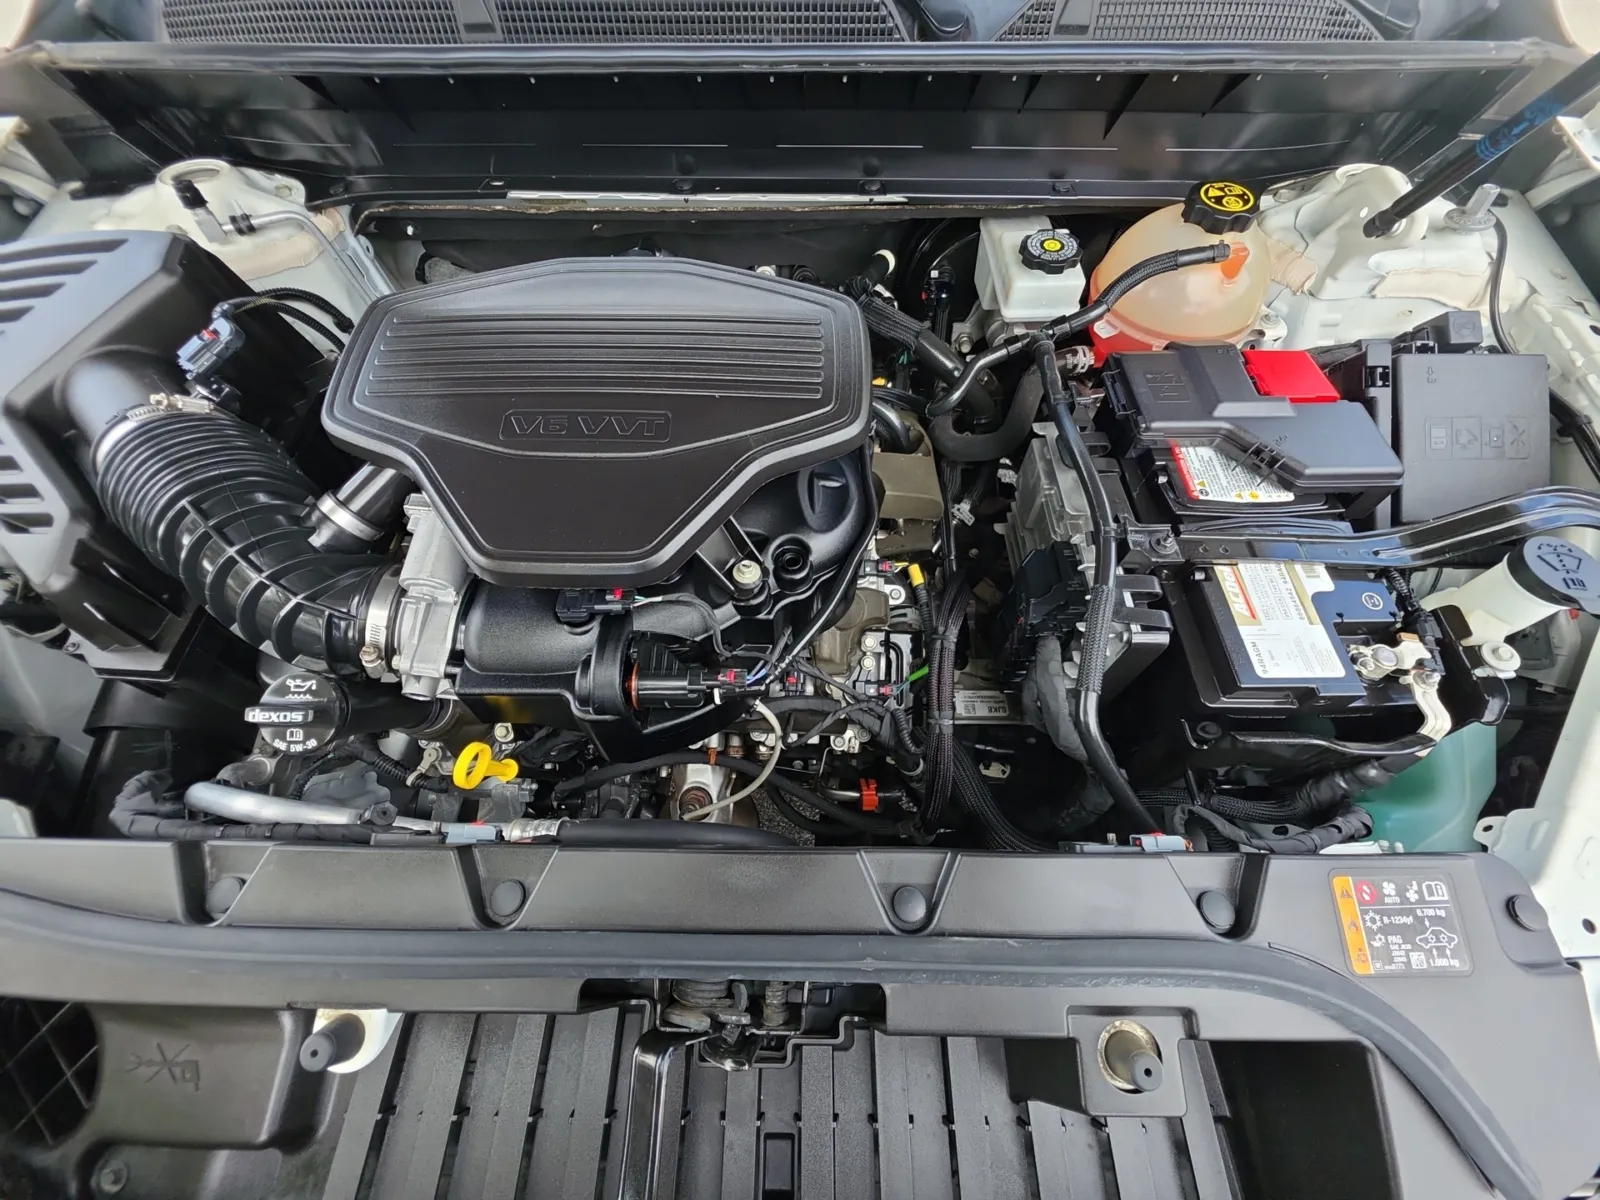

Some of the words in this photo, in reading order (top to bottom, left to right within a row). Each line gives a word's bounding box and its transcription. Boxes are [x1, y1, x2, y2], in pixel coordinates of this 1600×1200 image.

[510, 415, 568, 434] V6
[577, 416, 665, 436] VVT
[1250, 641, 1269, 675] 94RAGM
[248, 708, 305, 723] dexos
[273, 738, 288, 751] SAE
[289, 738, 318, 752] 5W-30
[1436, 908, 1446, 918] kg
[1387, 935, 1403, 944] PAG
